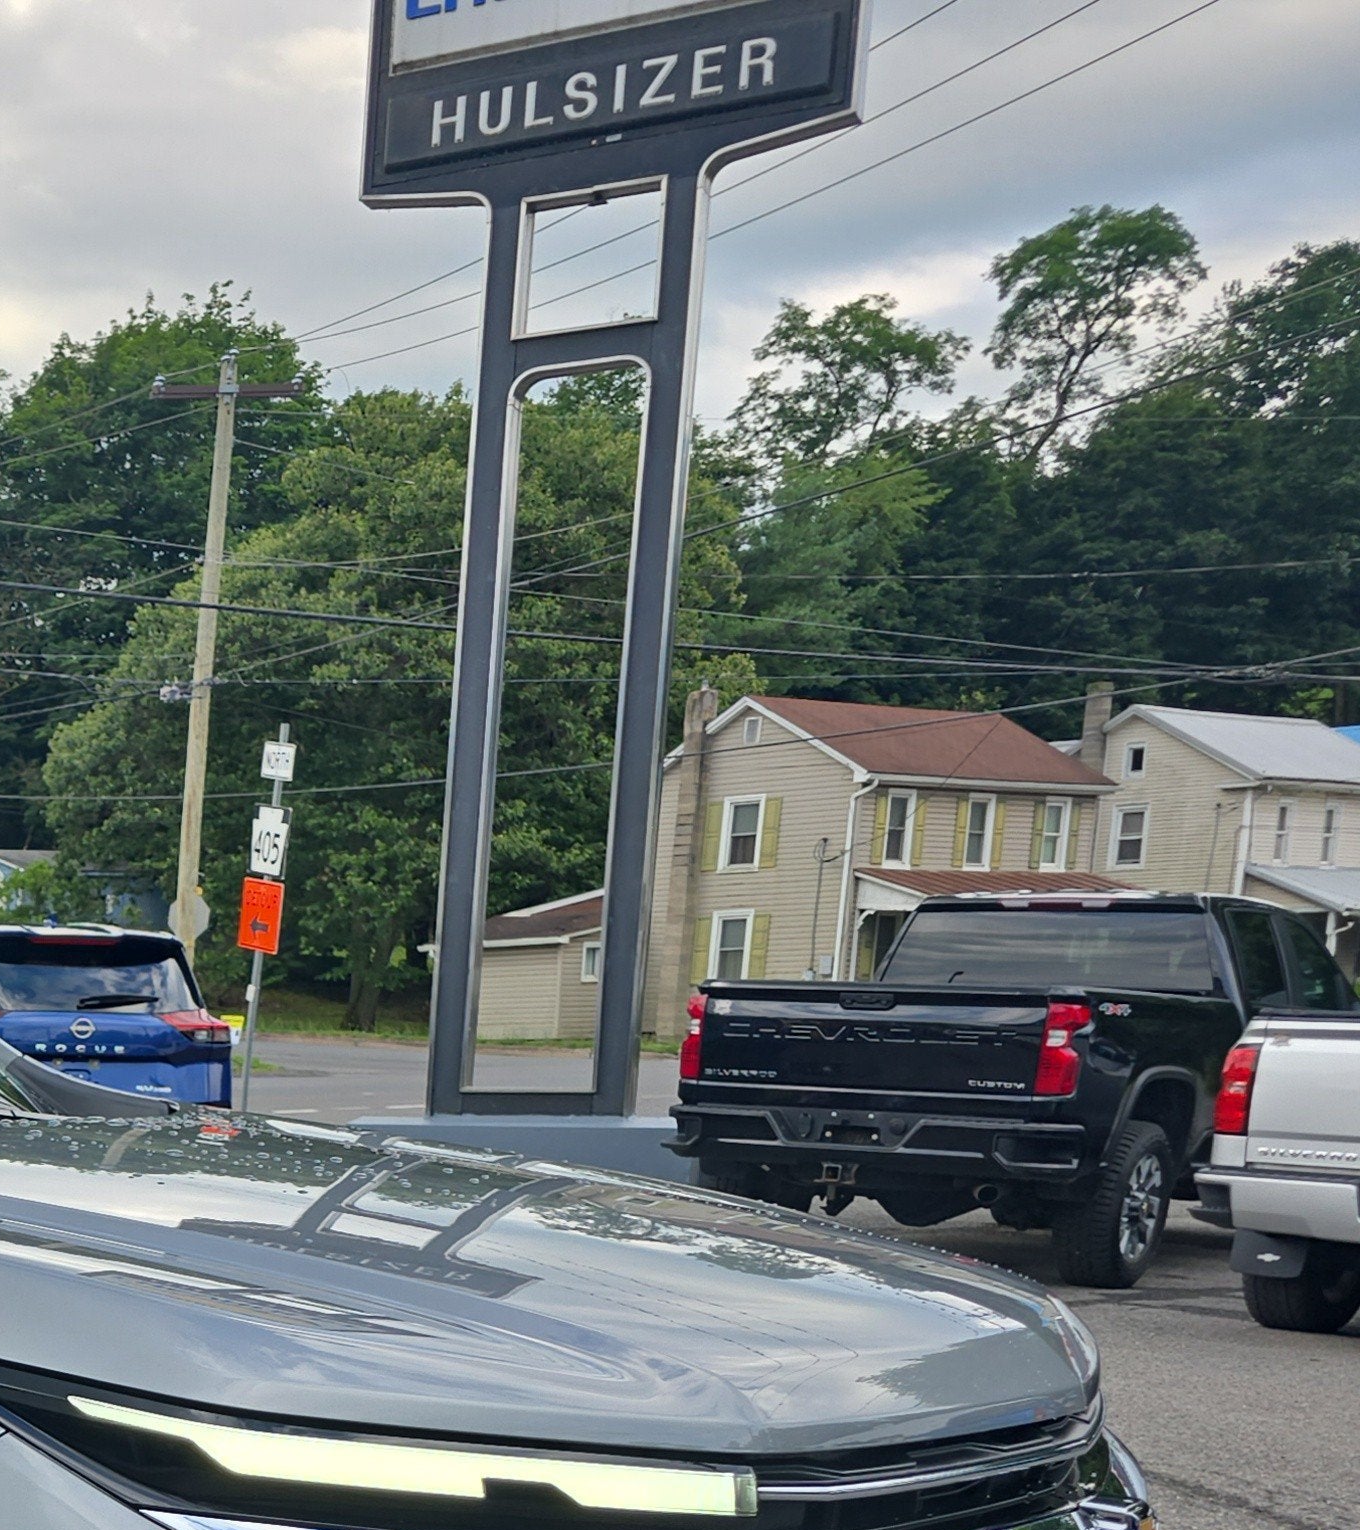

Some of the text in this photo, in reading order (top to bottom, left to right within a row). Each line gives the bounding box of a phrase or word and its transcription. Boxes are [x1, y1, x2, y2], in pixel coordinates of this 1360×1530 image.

[432, 37, 778, 148] HULSIZER
[254, 830, 281, 865] 405
[246, 889, 278, 909] DETOUR
[723, 1022, 1017, 1046] CHEVROLET
[34, 1042, 126, 1054] ROGUE
[704, 1067, 778, 1079] SILVERADO
[968, 1079, 1027, 1091] CUSTOM
